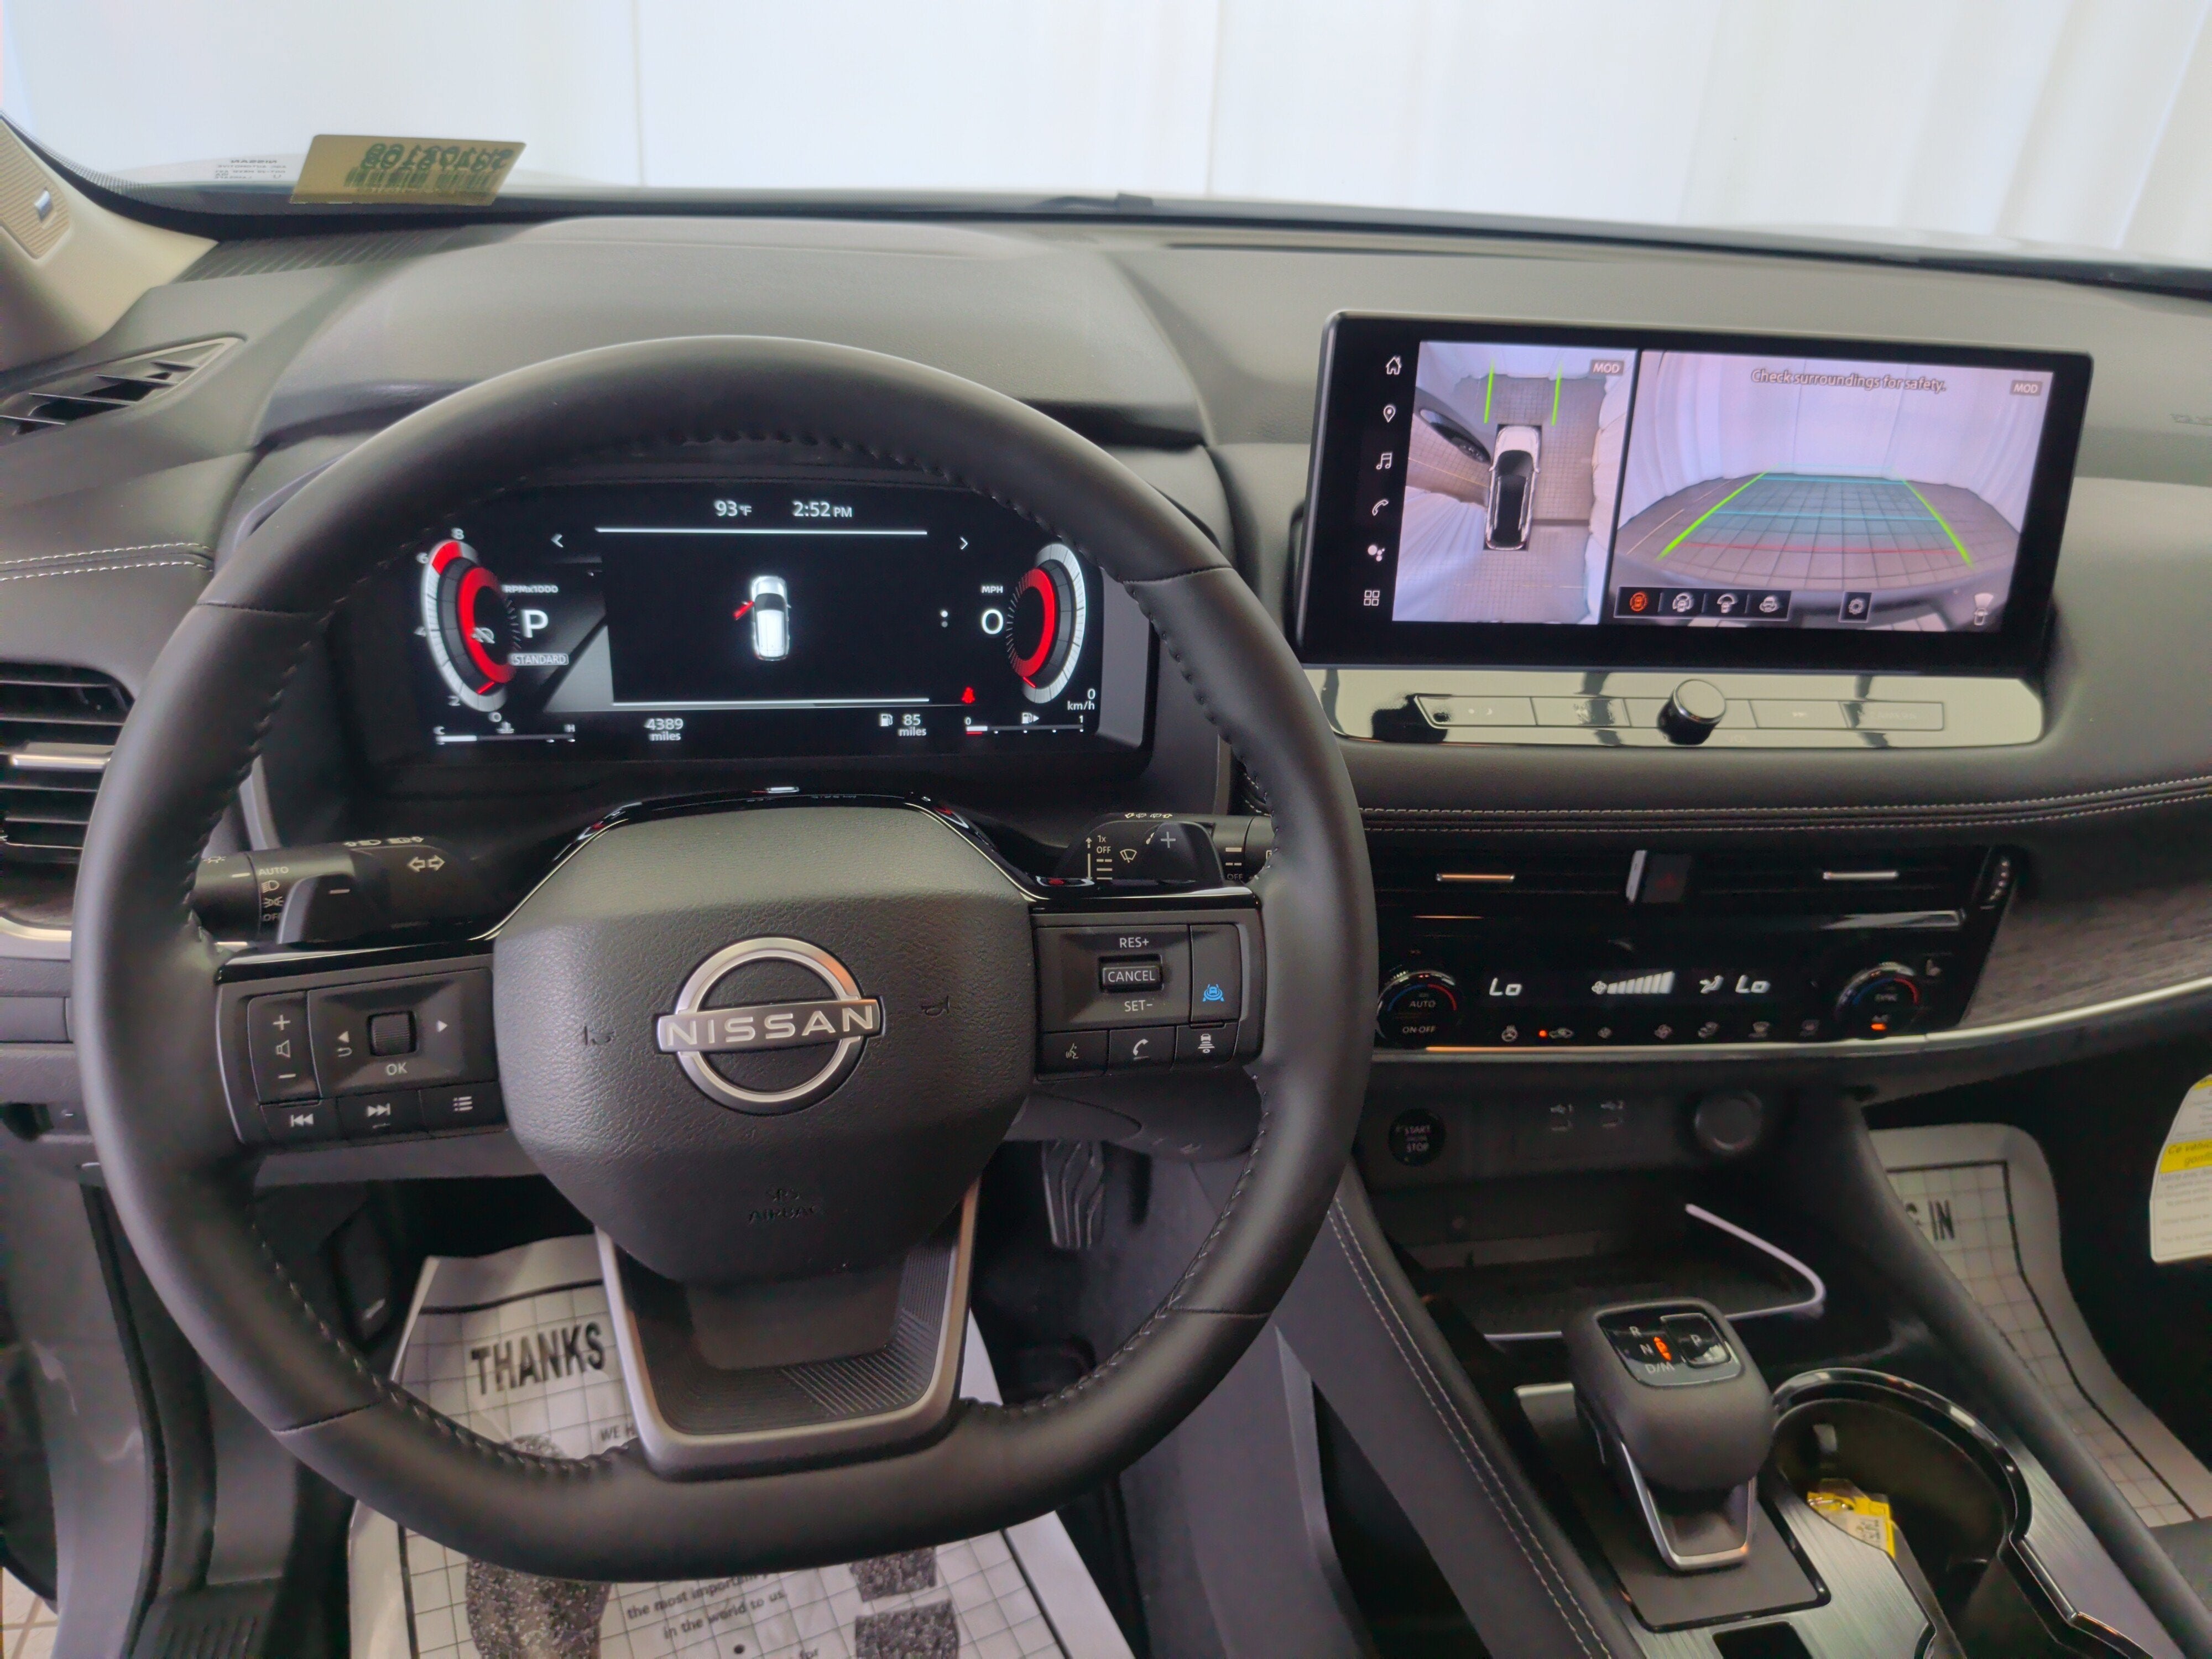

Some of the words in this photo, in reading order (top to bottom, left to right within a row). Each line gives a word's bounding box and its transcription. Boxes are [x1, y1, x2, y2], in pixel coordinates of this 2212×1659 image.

[1593, 362, 1620, 374] MOD
[1751, 368, 1792, 384] Check
[1793, 371, 1880, 390] surroundings
[1880, 374, 1903, 388] for
[1905, 377, 1947, 394] safety.
[2013, 382, 2038, 395] MOD
[792, 500, 831, 518] 2:52
[833, 507, 853, 518] PM
[451, 527, 465, 540] 8
[981, 585, 1004, 594] MPH
[521, 608, 549, 639] P
[980, 608, 1004, 635] 0
[512, 654, 567, 665] STANDARD
[1087, 688, 1096, 700] 0
[1067, 700, 1095, 711] km/h
[644, 717, 684, 731] 4389
[902, 714, 921, 727] 85
[649, 731, 681, 742] miles
[898, 726, 927, 737] miles
[1097, 834, 1107, 843] 1x
[1096, 846, 1112, 854] OFF
[258, 866, 289, 875] AUTO
[1119, 937, 1150, 948] RES+
[1108, 970, 1156, 983] CANCEL
[1408, 1000, 1437, 1008] AUTO
[665, 1004, 874, 1047] NISSAN
[387, 1062, 408, 1076] OK
[1640, 1343, 1654, 1355] N
[471, 1322, 606, 1395] THANKS
[1645, 1361, 1675, 1374] D/M
[627, 1604, 650, 1619] the
[654, 1591, 688, 1611] most
[680, 1617, 704, 1632] the
[707, 1604, 747, 1624] world
[750, 1597, 765, 1610] to
[769, 1589, 786, 1603] us
